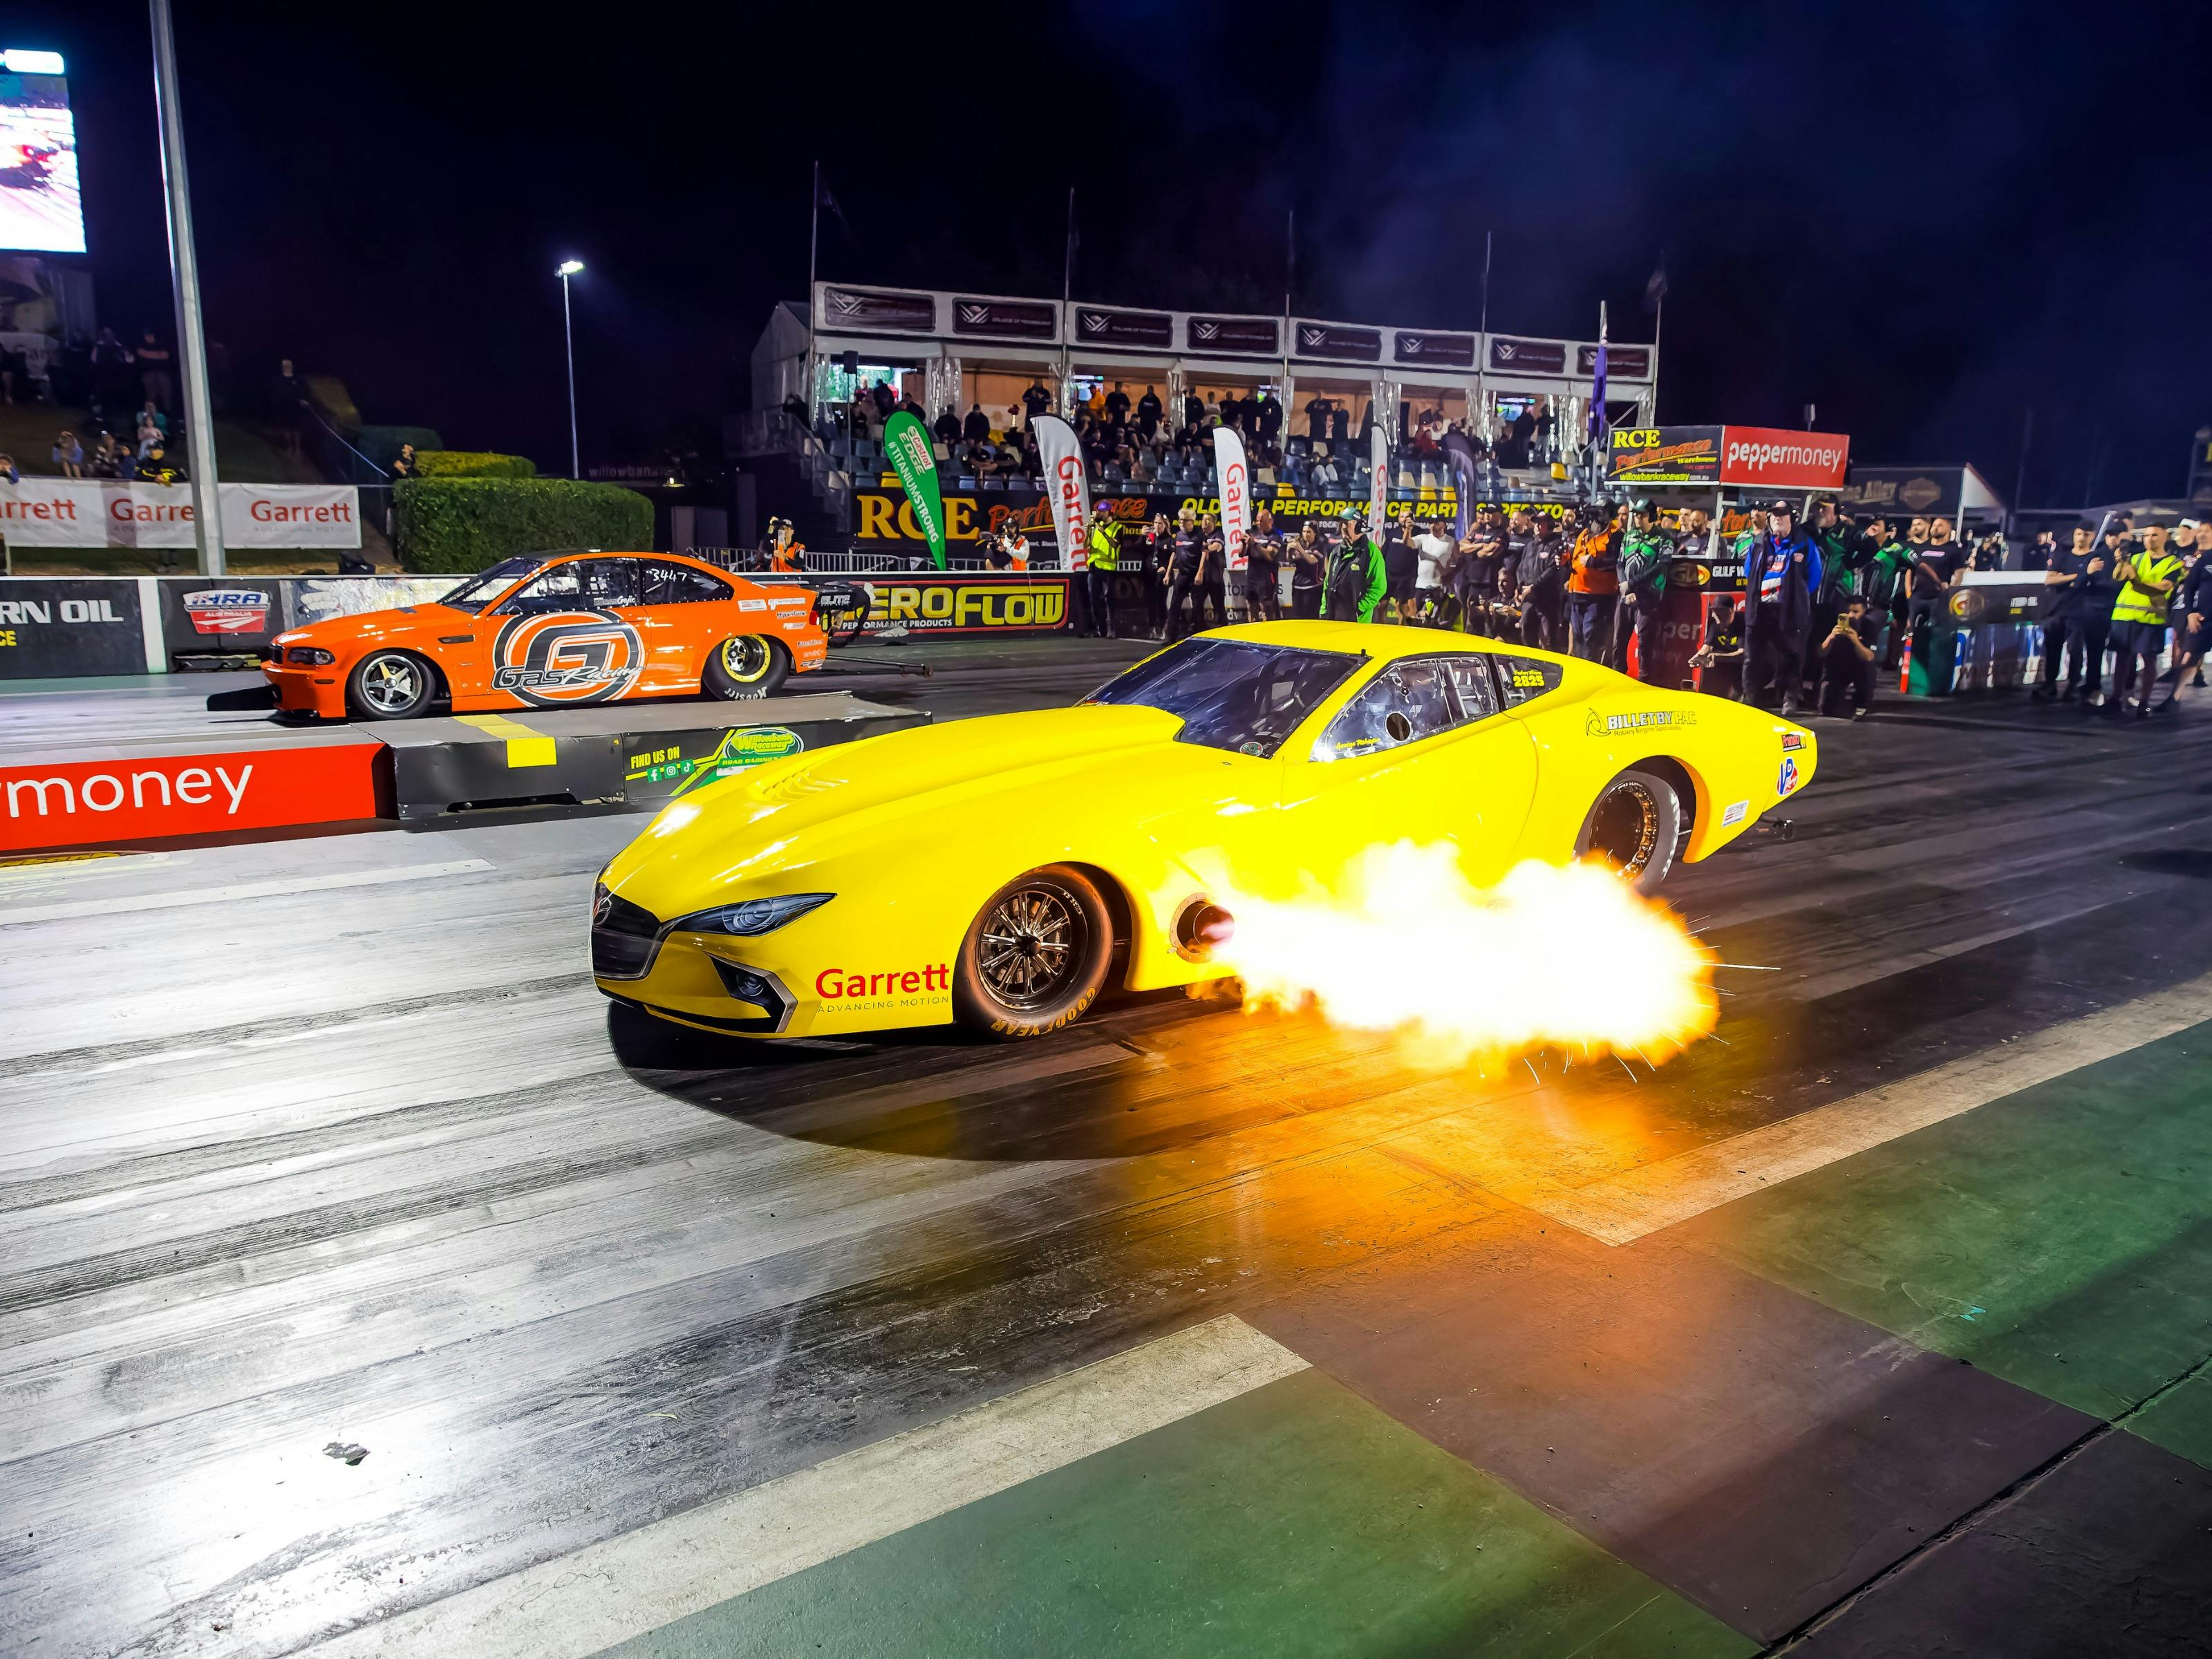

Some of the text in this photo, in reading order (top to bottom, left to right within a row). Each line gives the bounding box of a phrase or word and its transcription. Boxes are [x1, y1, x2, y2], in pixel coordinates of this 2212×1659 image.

[1613, 429, 1660, 448] RCE
[899, 433, 926, 476] EDGE
[912, 437, 932, 467] Castrol
[1727, 442, 1842, 473] peppermoney
[888, 441, 939, 543] #TITANIUMSTRONG
[0, 498, 77, 521] rrett
[111, 498, 194, 521] Garre
[251, 500, 351, 523] Garrett
[856, 495, 980, 540] RCE
[1057, 456, 1090, 571] Garrett
[1271, 499, 1412, 517] PERFORACE
[1416, 502, 1459, 518] PART
[651, 568, 687, 582] 3447
[1712, 565, 1736, 577] GULF
[59, 599, 124, 623] OIL
[843, 585, 1065, 626] EROFLOW
[843, 619, 953, 630] PERORMANCE PRODUCTS
[1513, 675, 1545, 687] 2825
[630, 746, 680, 769] FIND US ON
[0, 765, 254, 818] money
[815, 963, 950, 999] Garrett
[817, 996, 949, 1013] ADVANCING MOTION
